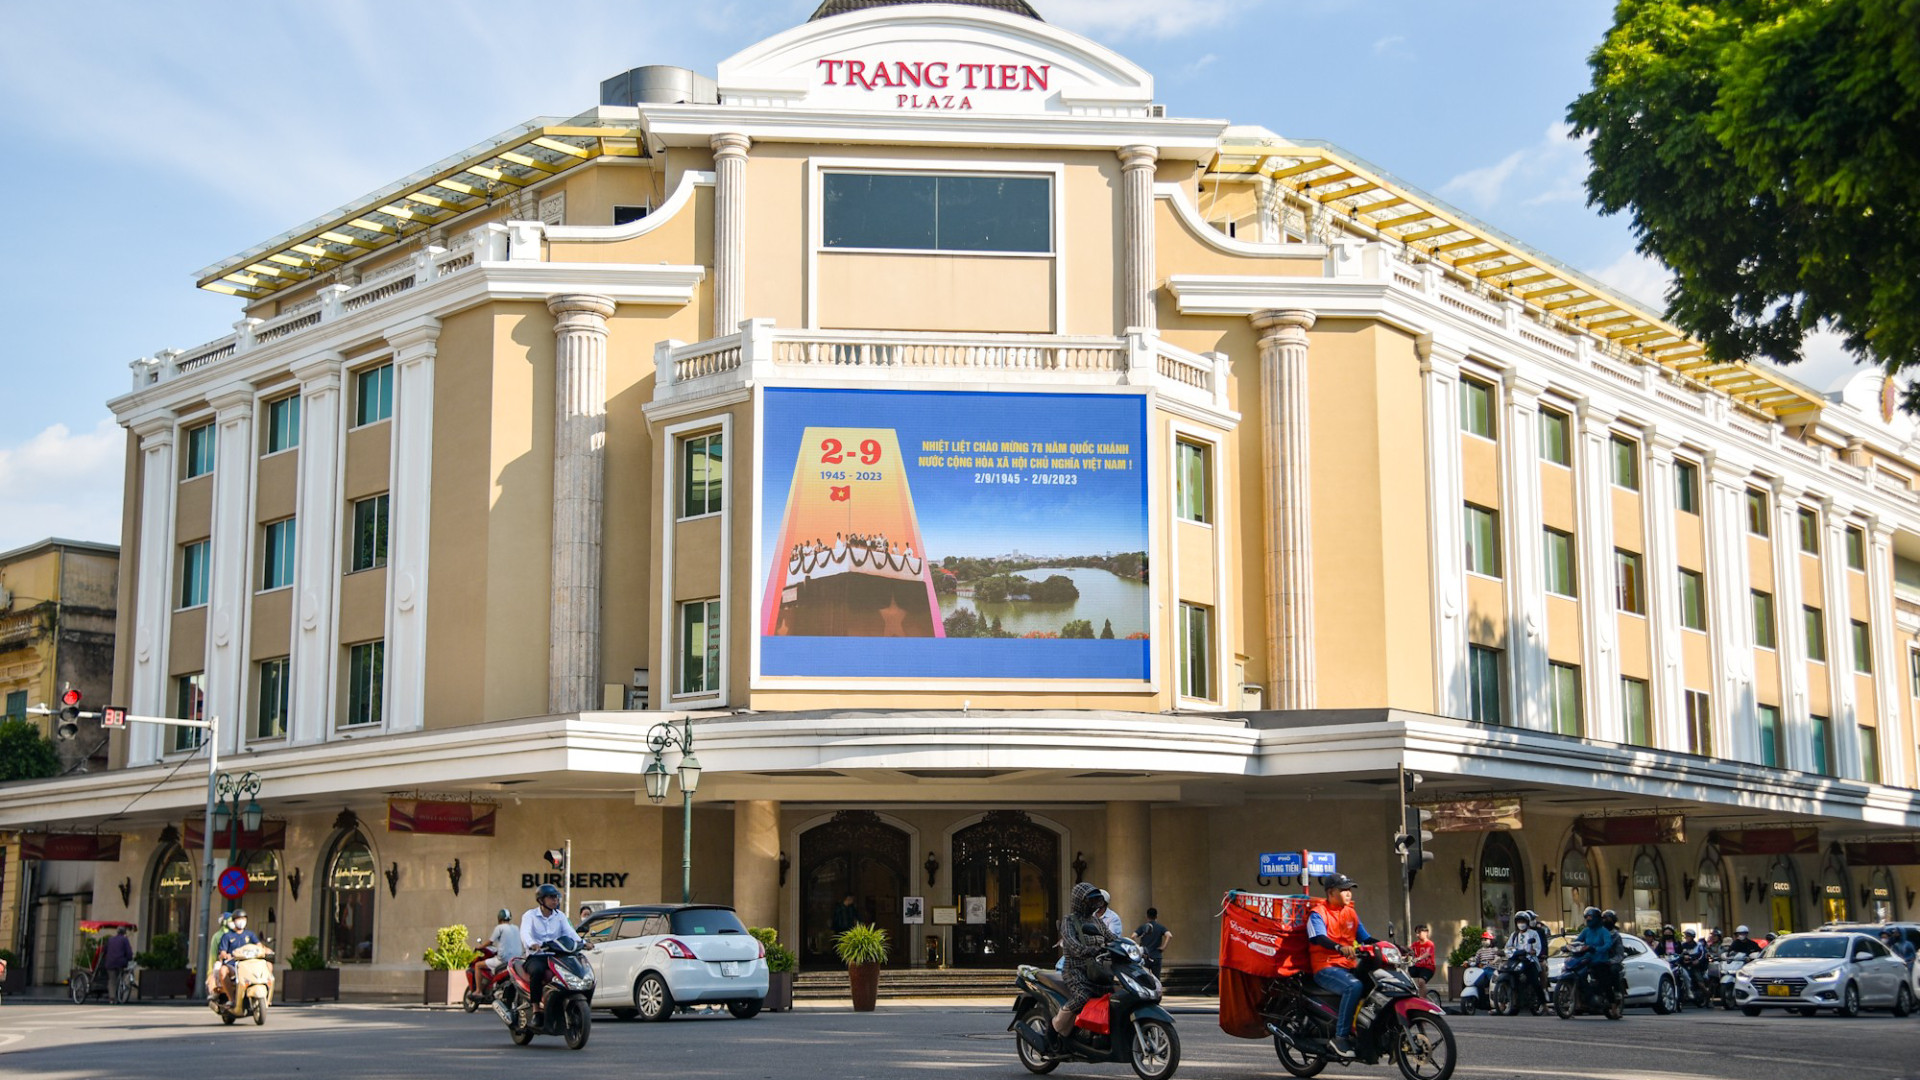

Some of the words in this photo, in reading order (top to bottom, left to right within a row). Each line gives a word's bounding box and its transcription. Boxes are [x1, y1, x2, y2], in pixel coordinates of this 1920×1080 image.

[818, 59, 950, 91] TRANG
[957, 63, 1051, 92] TIEN
[897, 94, 973, 110] PLAZA
[821, 438, 882, 465] 2-9
[922, 439, 949, 454] NHIỆT
[951, 439, 970, 454] LIỆT
[973, 440, 999, 453] CHÀO
[1031, 442, 1043, 453] 78
[1069, 440, 1095, 455] QUỐC
[1097, 442, 1129, 455] KHÁNH
[918, 455, 944, 467] NƯỚC
[947, 455, 972, 470] CỘNG
[997, 456, 1009, 468] XÃ
[1012, 456, 1028, 471] HỘI
[1082, 457, 1102, 472] VIỆT
[1104, 459, 1126, 470] NAM
[820, 471, 846, 480] 1945
[856, 472, 882, 481] 2023
[974, 473, 1020, 484] 2/9/1945
[1032, 474, 1078, 485] 2/9/2023
[1484, 866, 1510, 877] HUBLOT
[521, 873, 629, 888] BURBERRY
[1773, 882, 1790, 890] GUCCI
